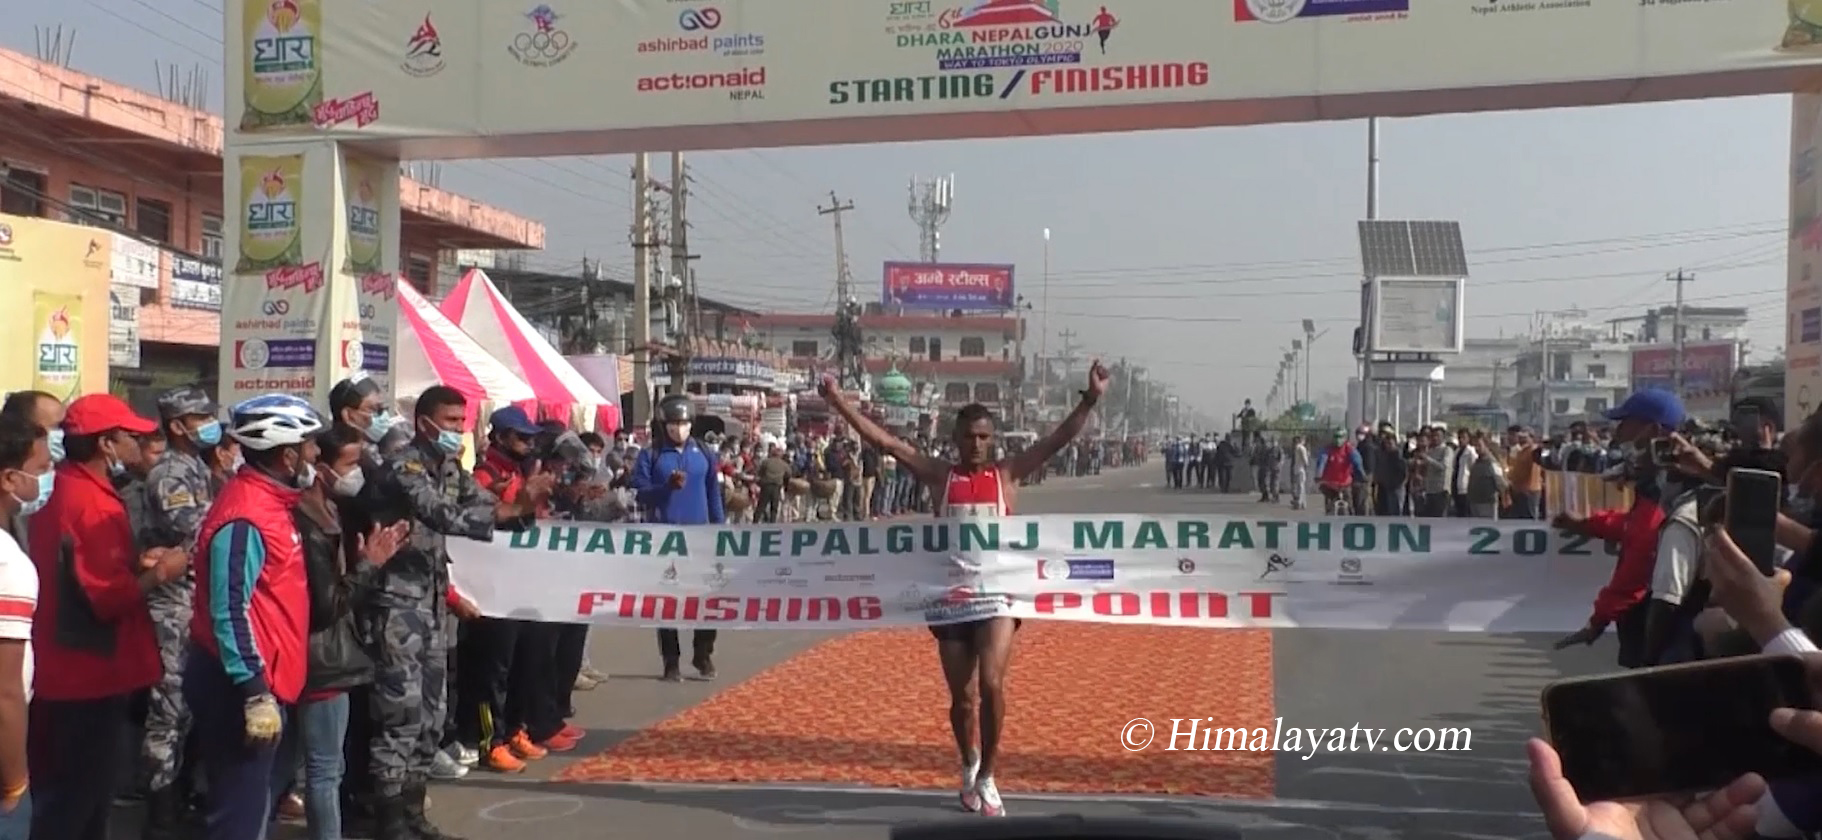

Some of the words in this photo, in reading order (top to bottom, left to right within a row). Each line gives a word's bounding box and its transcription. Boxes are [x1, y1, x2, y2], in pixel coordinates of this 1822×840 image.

[1471, 5, 1498, 16] Nepal
[1500, 3, 1536, 13] Athletic
[1538, 0, 1591, 10] Association
[637, 36, 708, 53] ashirbad
[713, 33, 764, 51] paints
[896, 31, 965, 48] DHARA
[972, 24, 1092, 43] NEPALGUNJ
[254, 36, 315, 62] धारा
[936, 43, 1040, 60] MARATHON
[1043, 40, 1084, 53] 2020
[944, 59, 968, 69] WAY
[972, 59, 986, 68] TO
[989, 56, 1024, 67] TOKYO
[1026, 54, 1075, 65] OLYMPIC
[829, 73, 994, 104] STARTING
[1031, 62, 1209, 95] FINISHING
[729, 90, 765, 100] NEPAL
[249, 202, 296, 222] धारा
[236, 320, 281, 330] ashirbad
[284, 318, 316, 330] paints
[40, 343, 78, 364] धारा
[510, 526, 687, 556] DHARA
[716, 521, 1039, 557] NEPALGUNJ
[1073, 521, 1431, 553] MARATHON
[577, 592, 883, 621] FINISHING
[1034, 592, 1288, 618] POINT
